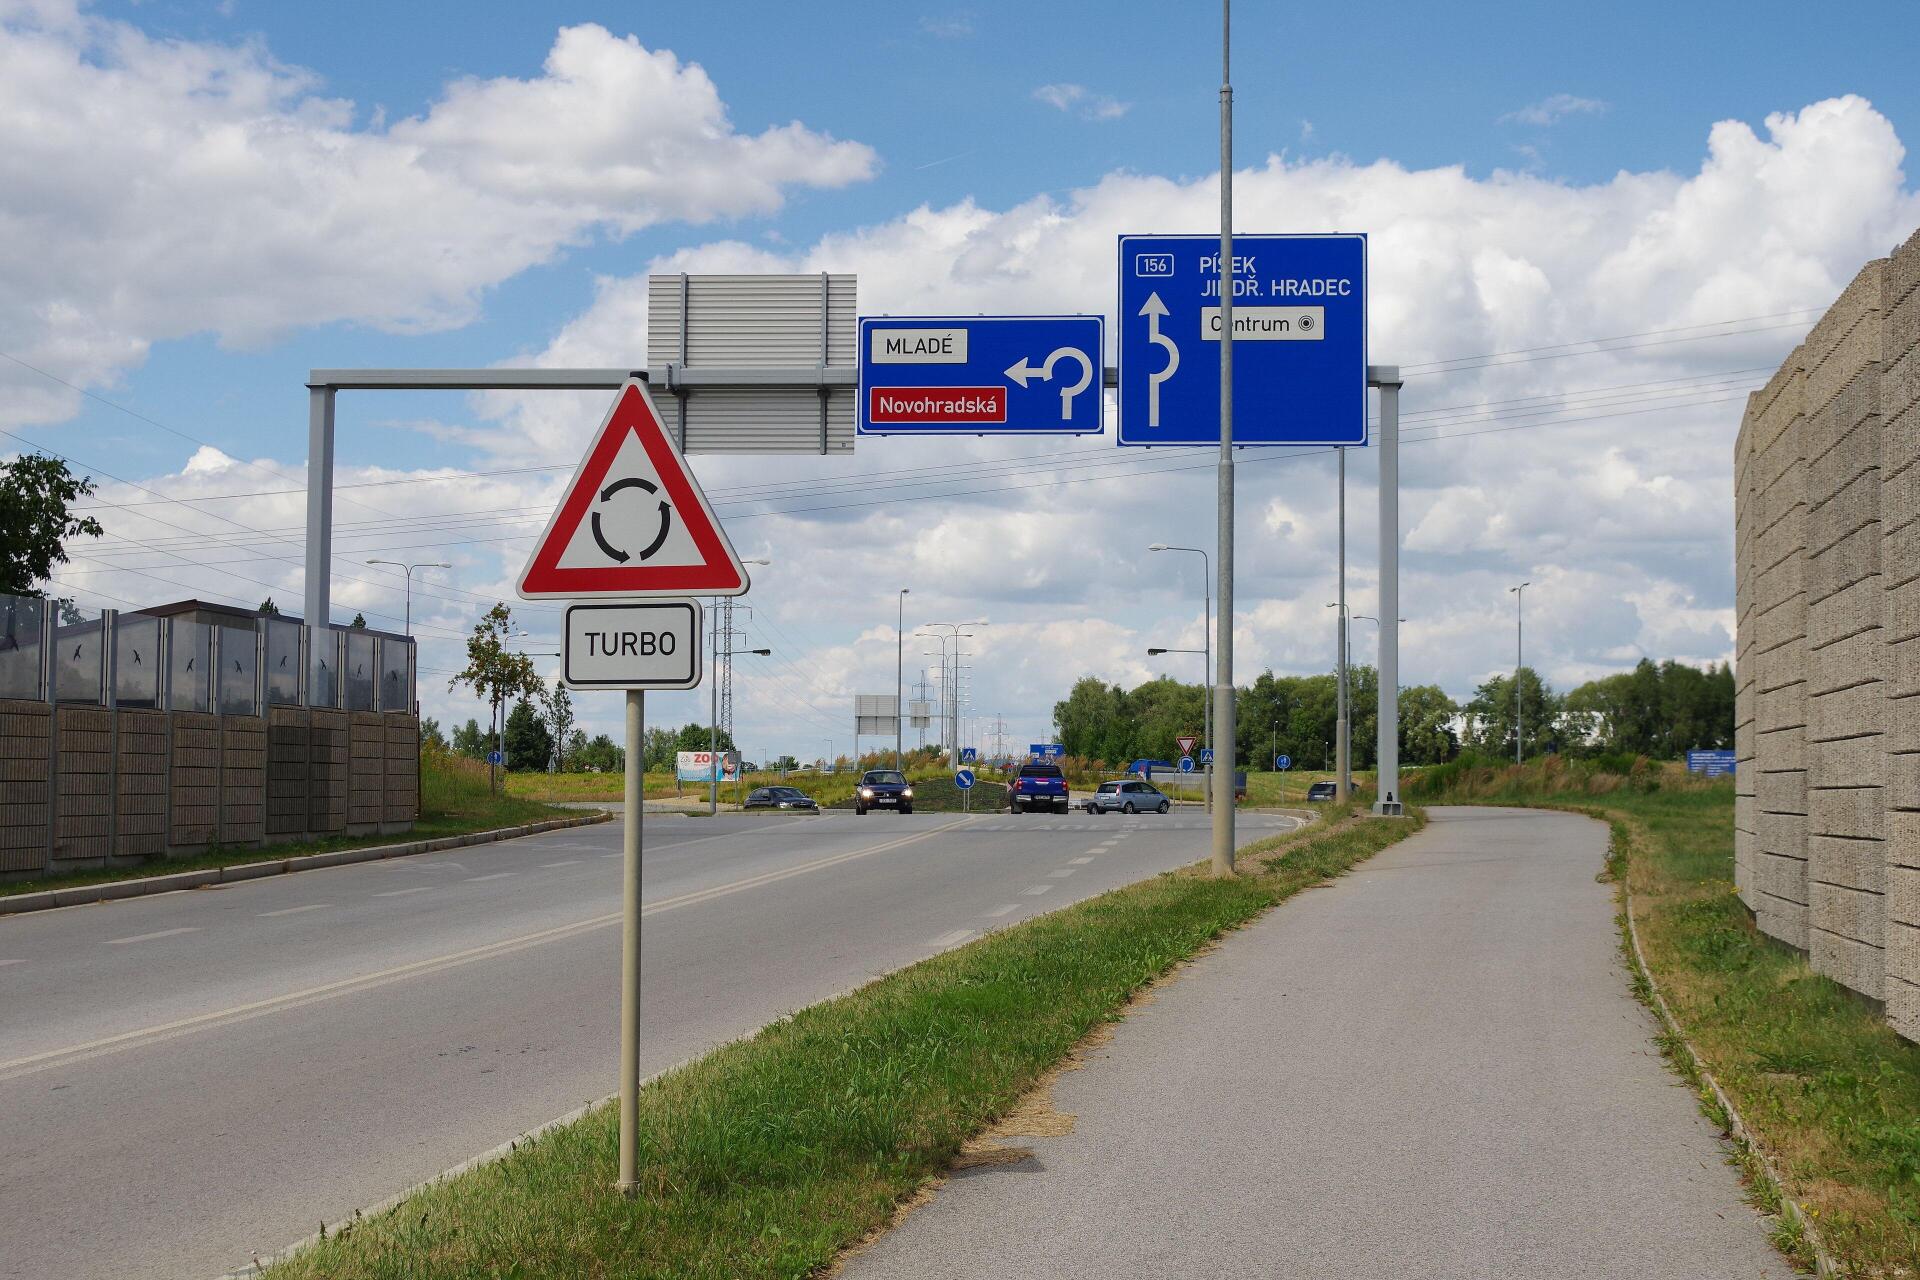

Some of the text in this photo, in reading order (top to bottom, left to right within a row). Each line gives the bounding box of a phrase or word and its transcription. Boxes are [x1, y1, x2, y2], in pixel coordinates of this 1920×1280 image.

[1143, 258, 1167, 272] 156
[1271, 279, 1351, 296] HRADEC
[1210, 315, 1290, 331] Cntrum
[886, 334, 953, 354] MLADÉ
[879, 395, 997, 414] Novohradská
[585, 631, 676, 657] TURBO
